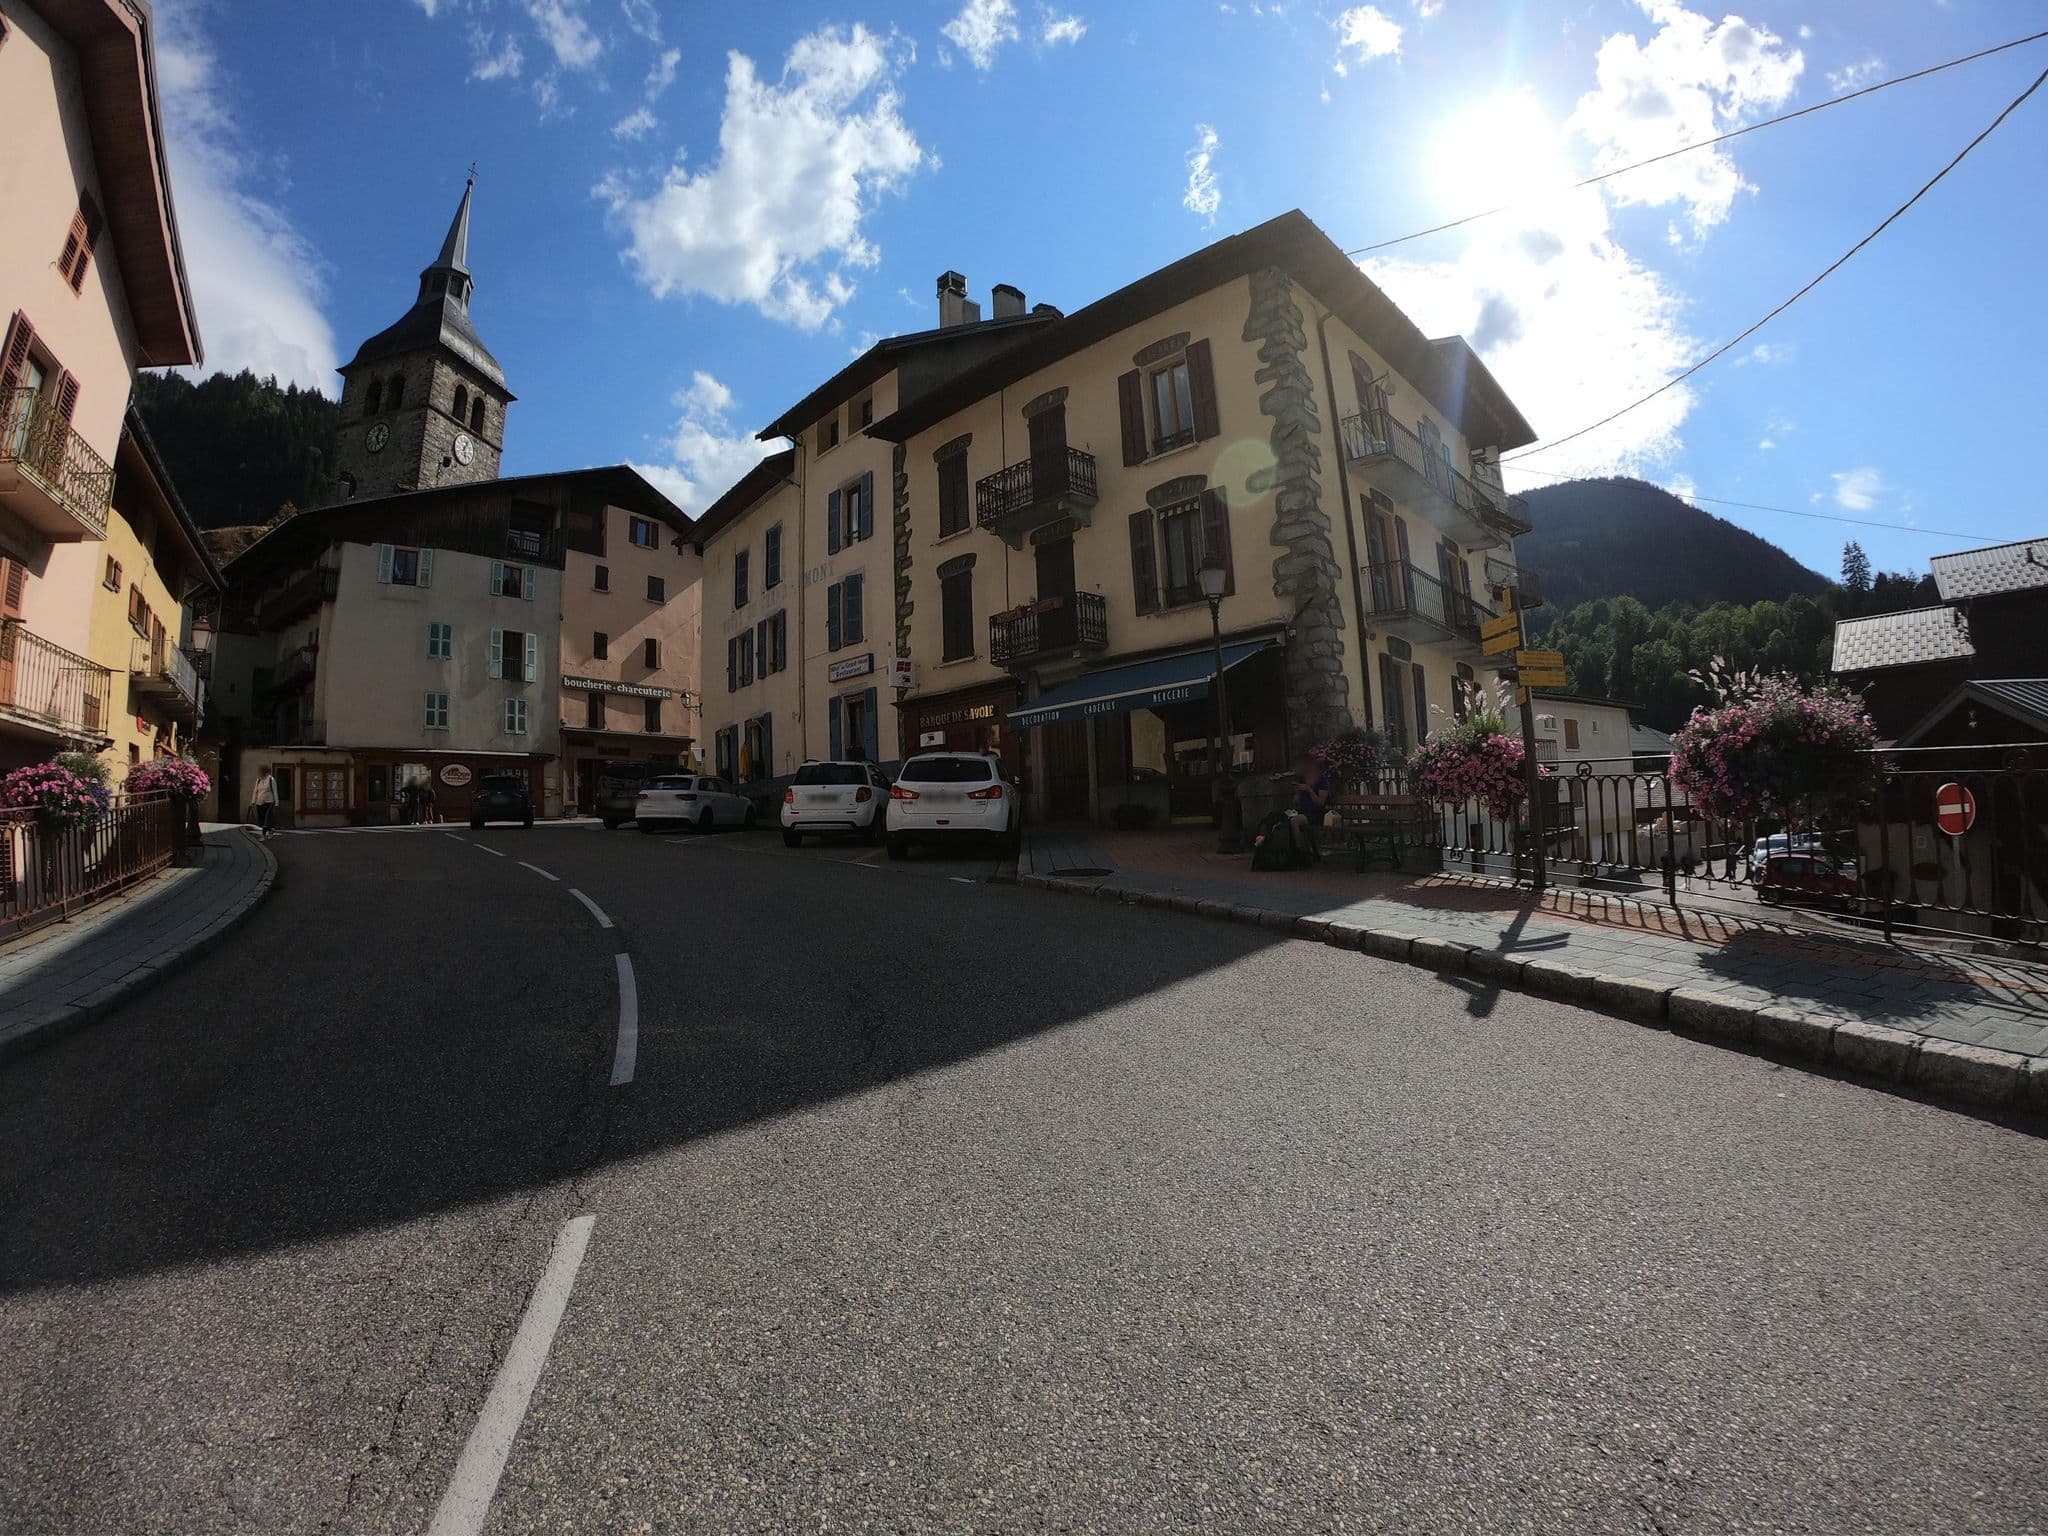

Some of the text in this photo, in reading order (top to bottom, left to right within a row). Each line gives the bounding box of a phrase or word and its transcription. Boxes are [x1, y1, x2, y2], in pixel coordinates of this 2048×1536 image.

[1083, 701, 1115, 715] CADEAUX
[1152, 687, 1189, 703] MERCERIE
[919, 704, 994, 727] BANQUE DE SAVOIE
